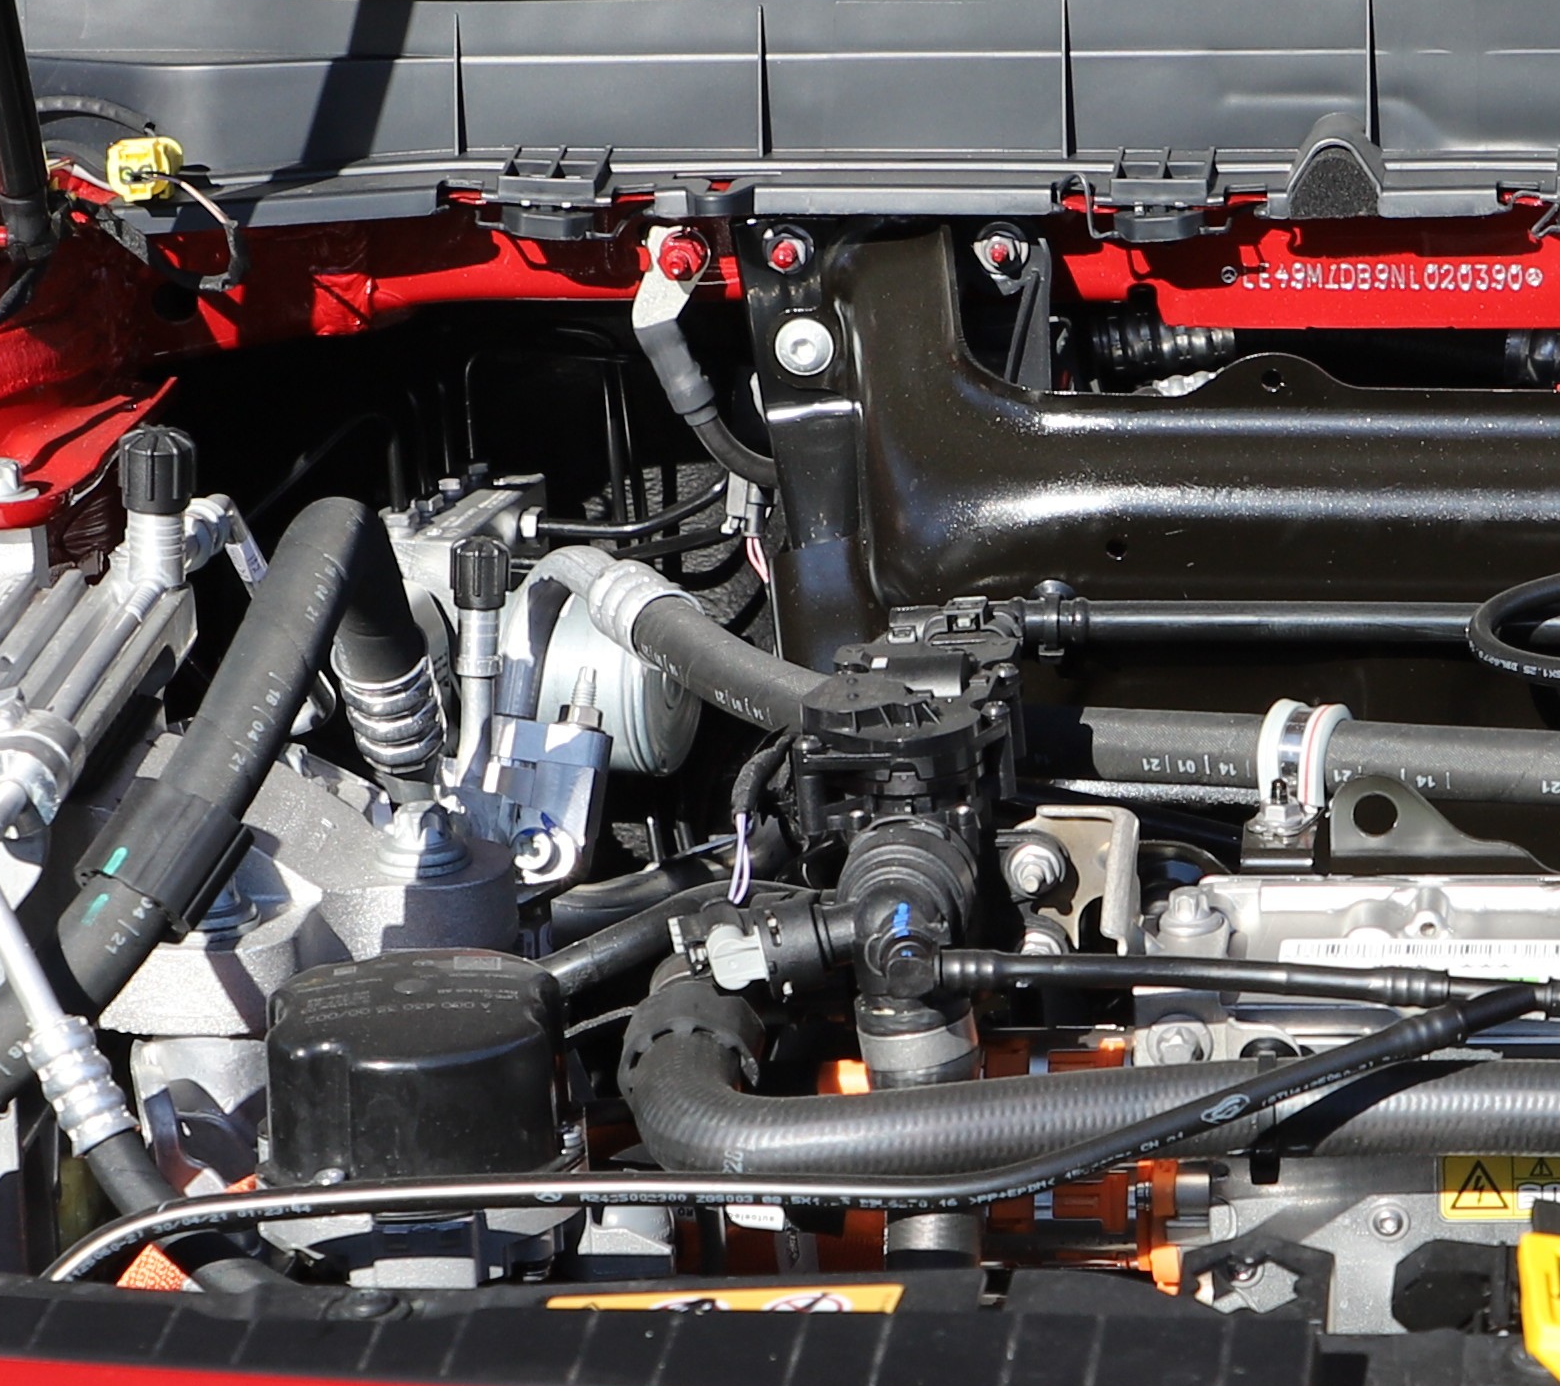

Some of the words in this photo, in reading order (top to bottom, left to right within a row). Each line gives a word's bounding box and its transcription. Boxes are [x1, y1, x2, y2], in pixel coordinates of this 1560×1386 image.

[242, 718, 269, 745] 04
[224, 750, 250, 776] 21
[100, 929, 131, 958] 21
